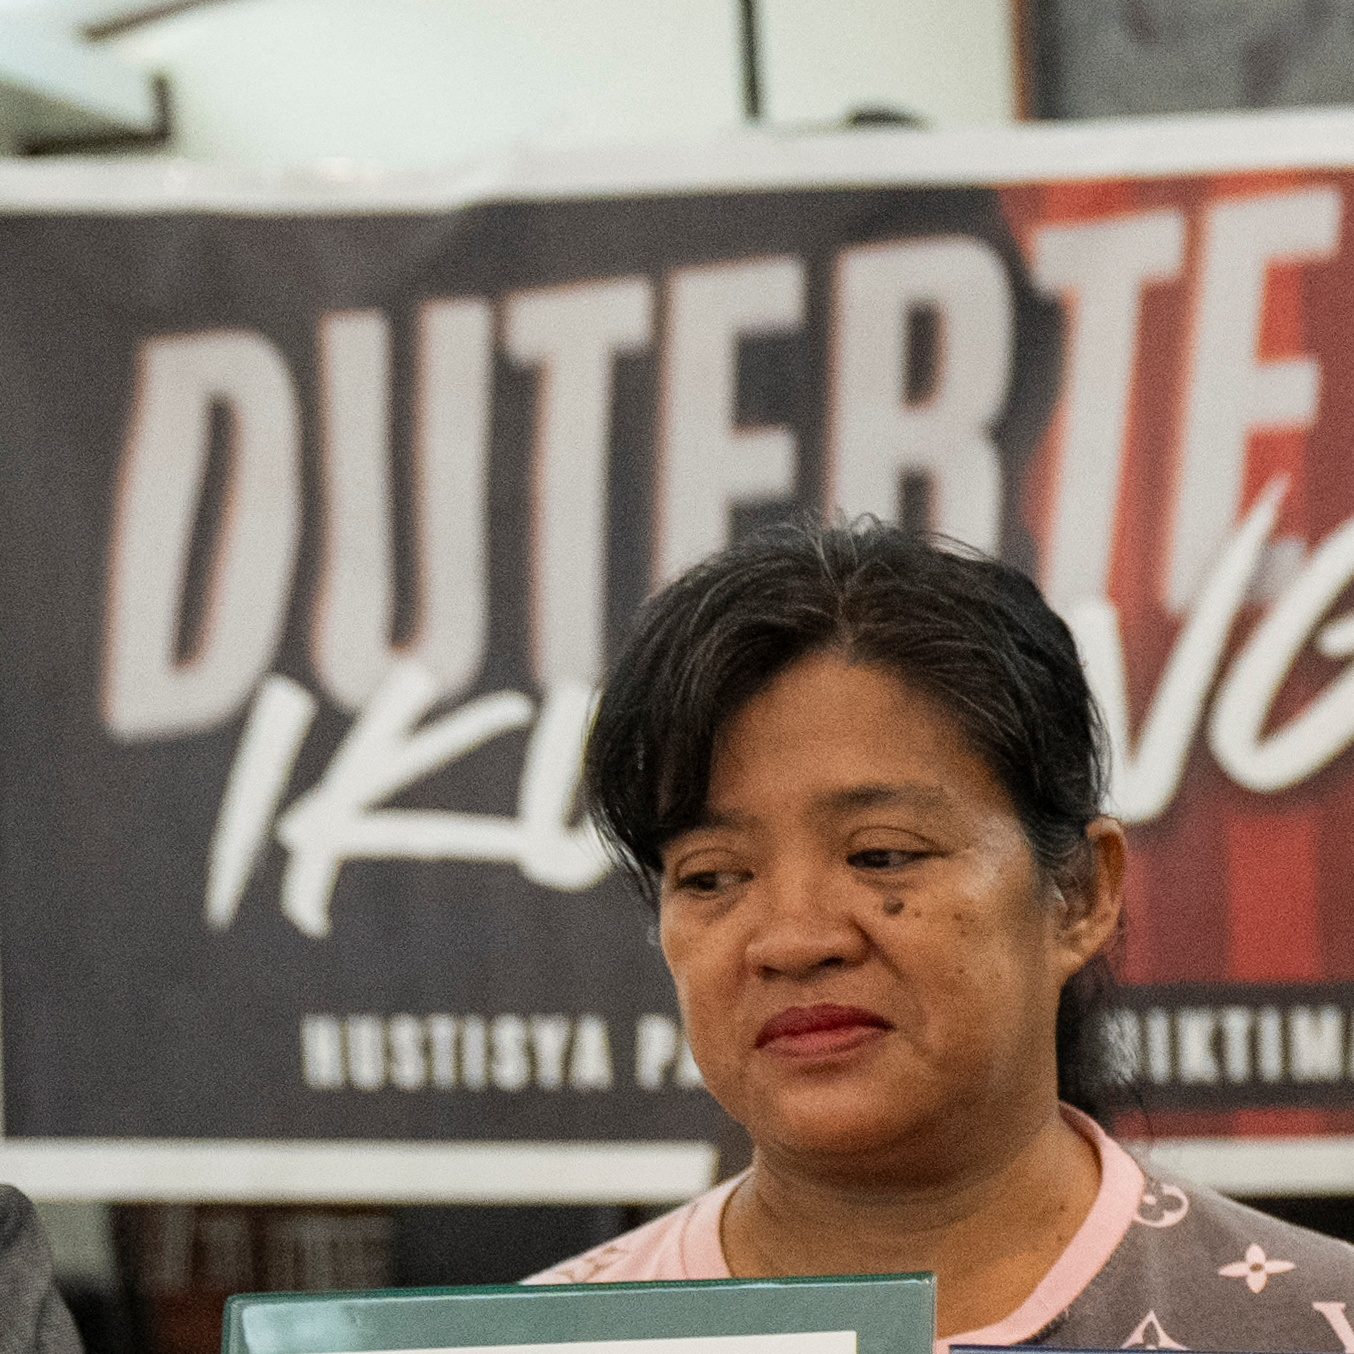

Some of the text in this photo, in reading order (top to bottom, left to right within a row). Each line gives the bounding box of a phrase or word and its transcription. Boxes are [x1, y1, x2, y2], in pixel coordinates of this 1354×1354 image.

[102, 182, 1343, 745] DUTERTE
[302, 1013, 702, 1091] HUSTISYA PA
